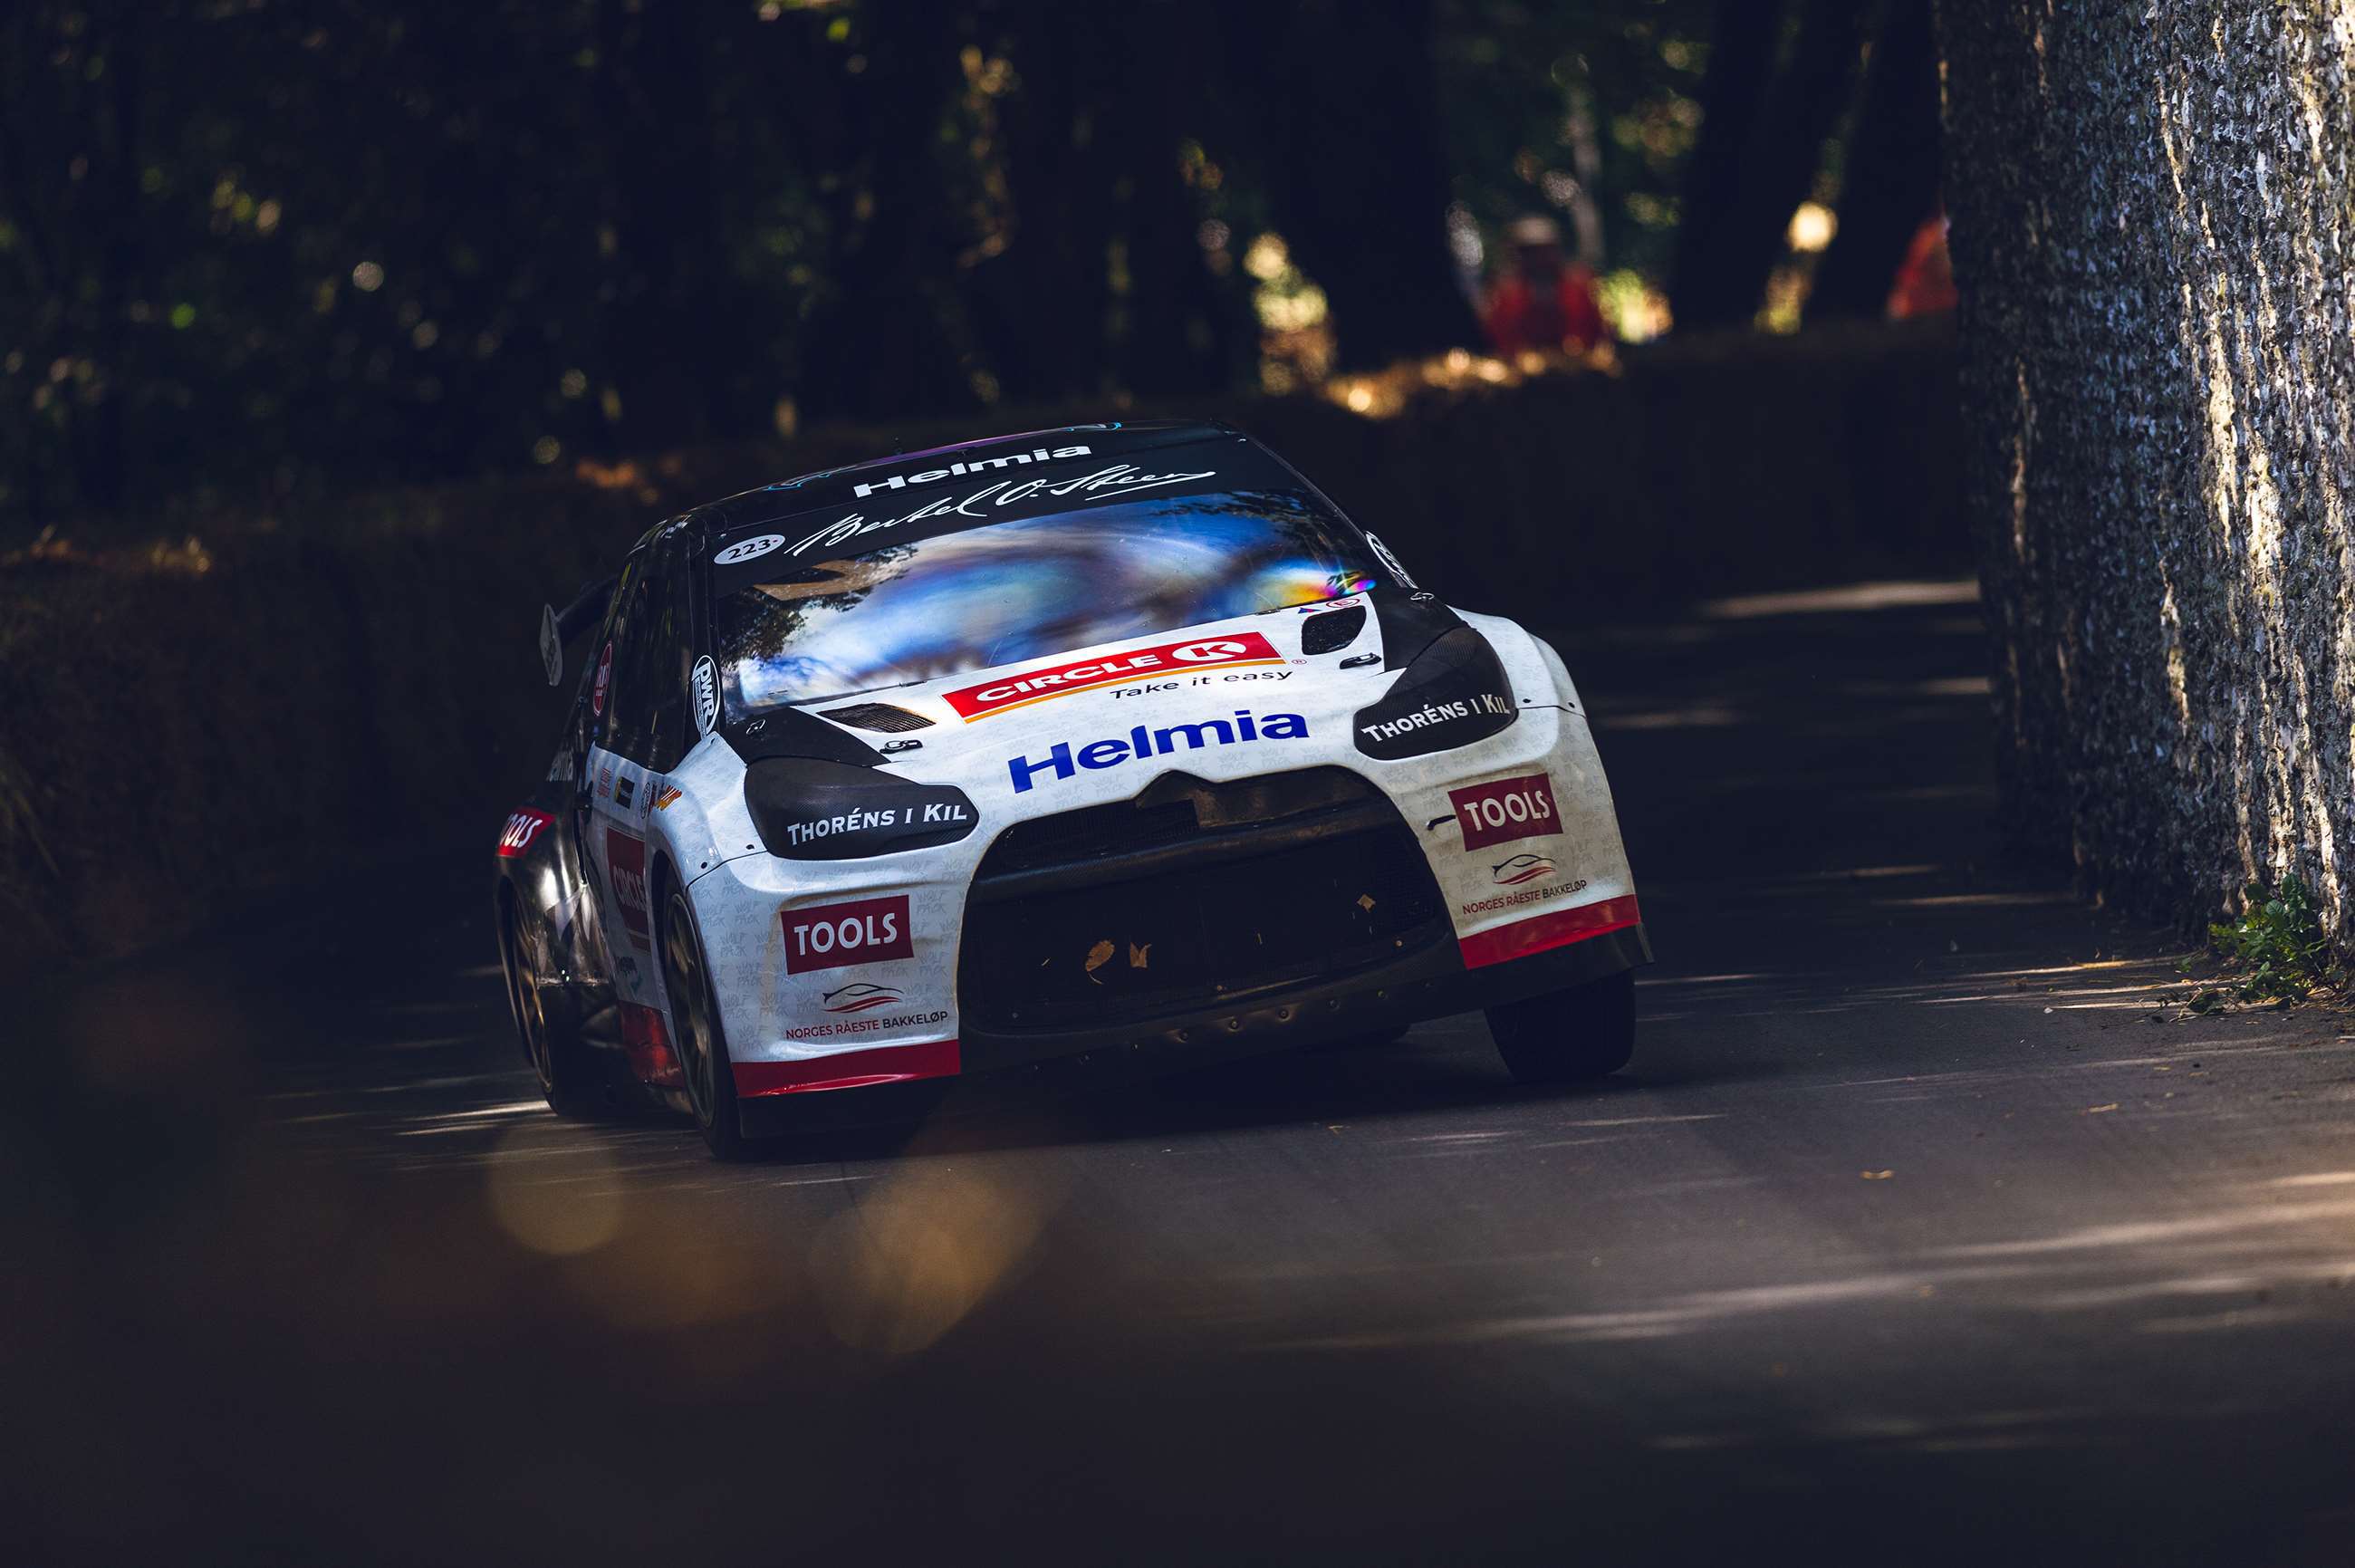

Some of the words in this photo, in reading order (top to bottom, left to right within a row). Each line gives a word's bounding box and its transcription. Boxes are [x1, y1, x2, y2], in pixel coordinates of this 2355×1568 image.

[853, 445, 1092, 498] Helmia
[727, 540, 771, 560] 223
[976, 654, 1162, 702] CIRCLE
[1110, 680, 1179, 700] Take
[1192, 676, 1216, 688] it
[1223, 669, 1293, 682] easy
[691, 661, 715, 736] PWR
[1360, 704, 1469, 742] THORÉNS
[1007, 710, 1310, 794] Helmia
[787, 807, 896, 846] THORÉNS
[1464, 790, 1551, 832] TOOLS
[1462, 895, 1504, 915] NORGES
[1505, 890, 1541, 907] RÅESTE
[1543, 880, 1587, 899] BAKKELØP
[794, 912, 898, 956] TOOLS
[785, 1025, 833, 1039] NORGES
[835, 1020, 880, 1034] RÅESTE
[882, 1011, 948, 1029] BAKKELØP
